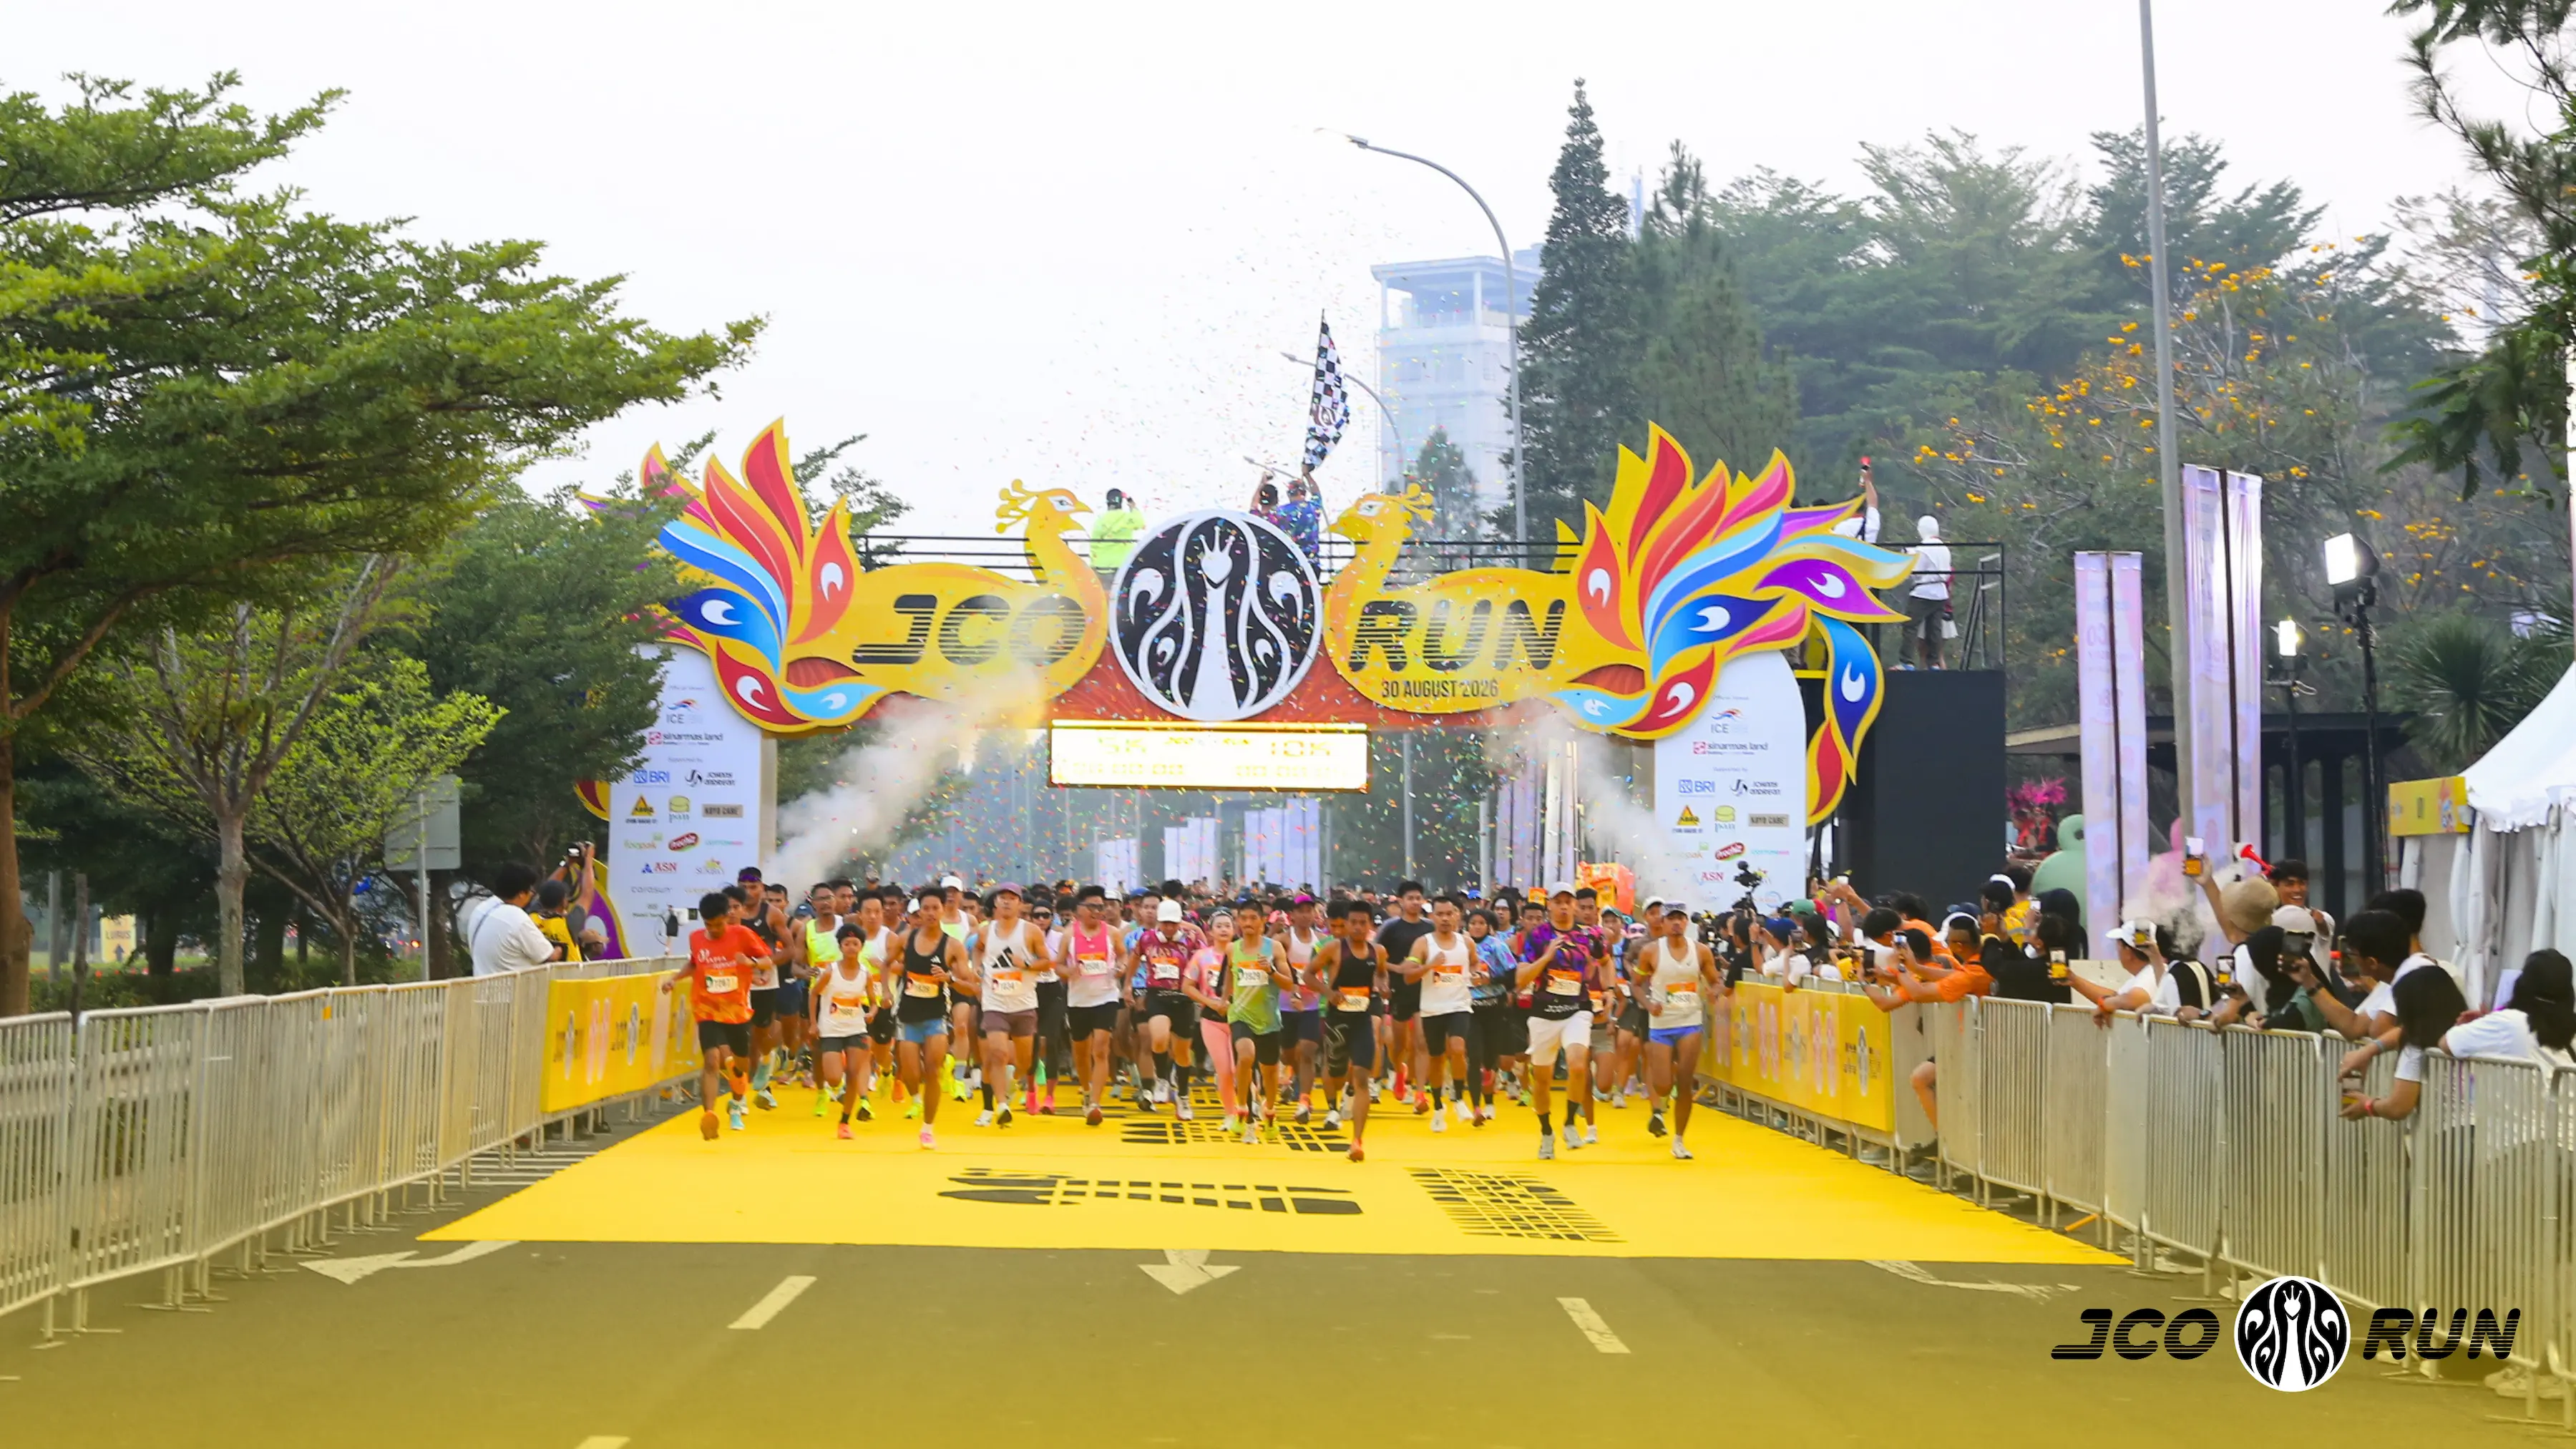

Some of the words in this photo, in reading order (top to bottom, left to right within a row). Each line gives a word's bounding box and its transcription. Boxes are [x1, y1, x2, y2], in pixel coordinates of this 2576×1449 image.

[852, 595, 1084, 665] JCO
[1348, 599, 1566, 673] RUN
[1382, 680, 1399, 698] 30
[1404, 680, 1457, 697] AUGUST
[1463, 680, 1498, 697] 2026
[667, 714, 684, 724] ICE
[1710, 723, 1729, 733] ICE
[705, 732, 723, 741] land
[1749, 742, 1768, 751] land
[649, 771, 670, 783] BRI
[1694, 781, 1715, 792] BRI
[655, 862, 677, 872] ASN
[1701, 872, 1724, 881] ASN
